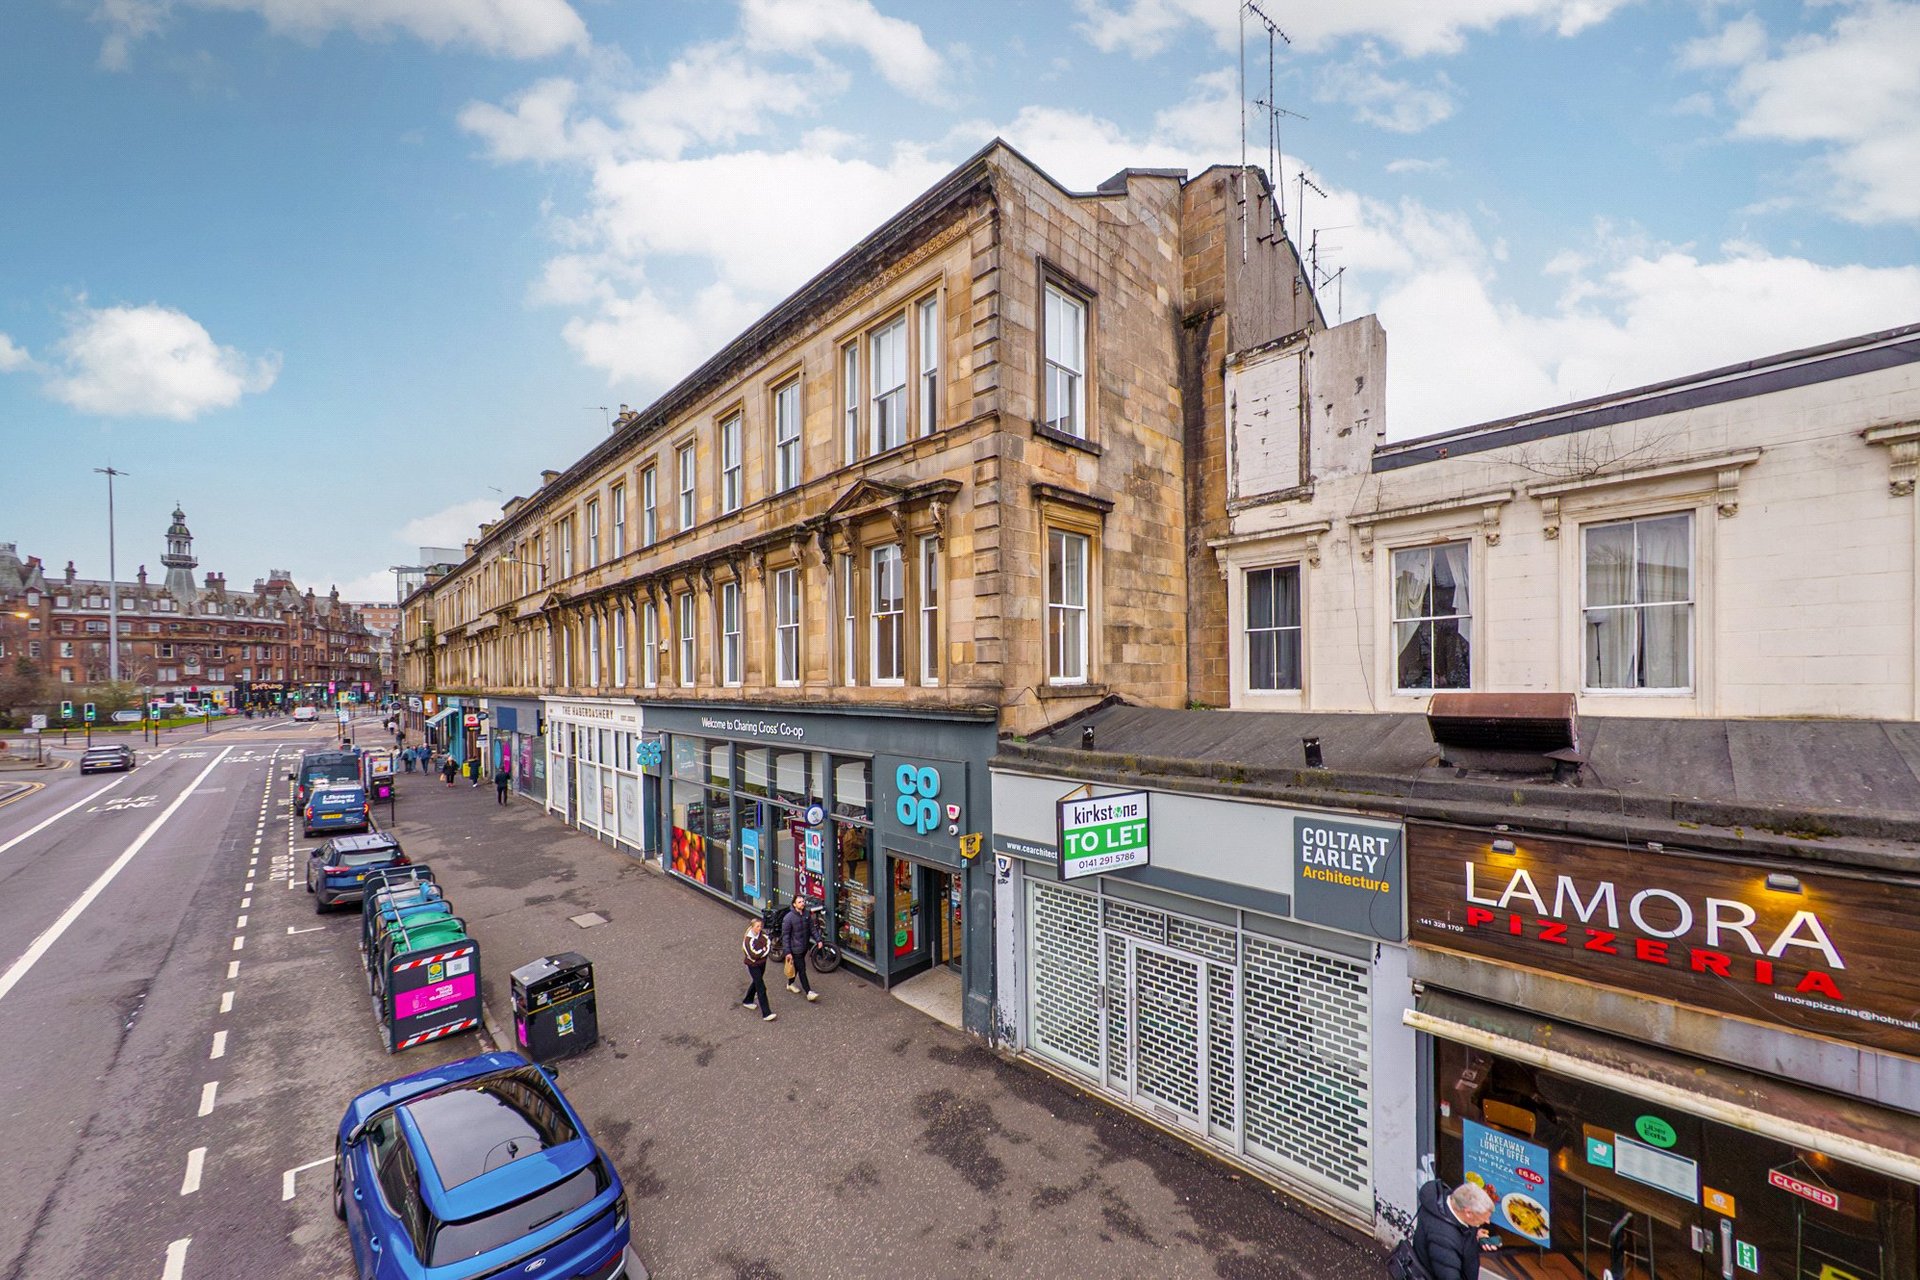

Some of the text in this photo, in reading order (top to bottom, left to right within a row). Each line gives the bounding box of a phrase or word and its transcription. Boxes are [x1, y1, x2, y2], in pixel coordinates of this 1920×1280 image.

[562, 706, 571, 716] THE
[573, 707, 614, 720] HABERDASHERY
[701, 717, 726, 730] Welcome
[726, 720, 733, 730] to
[733, 719, 758, 736] Charing
[780, 722, 804, 739] Co-op
[1065, 823, 1146, 854] TO LET
[1302, 827, 1390, 856] COLTART
[1079, 859, 1097, 869] 0141
[1100, 856, 1113, 865] 291
[1115, 852, 1135, 862] 5786
[1302, 845, 1378, 874] EARLEY
[1302, 865, 1390, 893] Architecture
[1465, 861, 1846, 970] LAMORA
[1466, 906, 1845, 1000] PIZZERIA
[1480, 1139, 1530, 1166] LUNCH OFFER
[1484, 1131, 1526, 1154] TAKEAWAY
[1773, 1175, 1833, 1205] CLOSED
